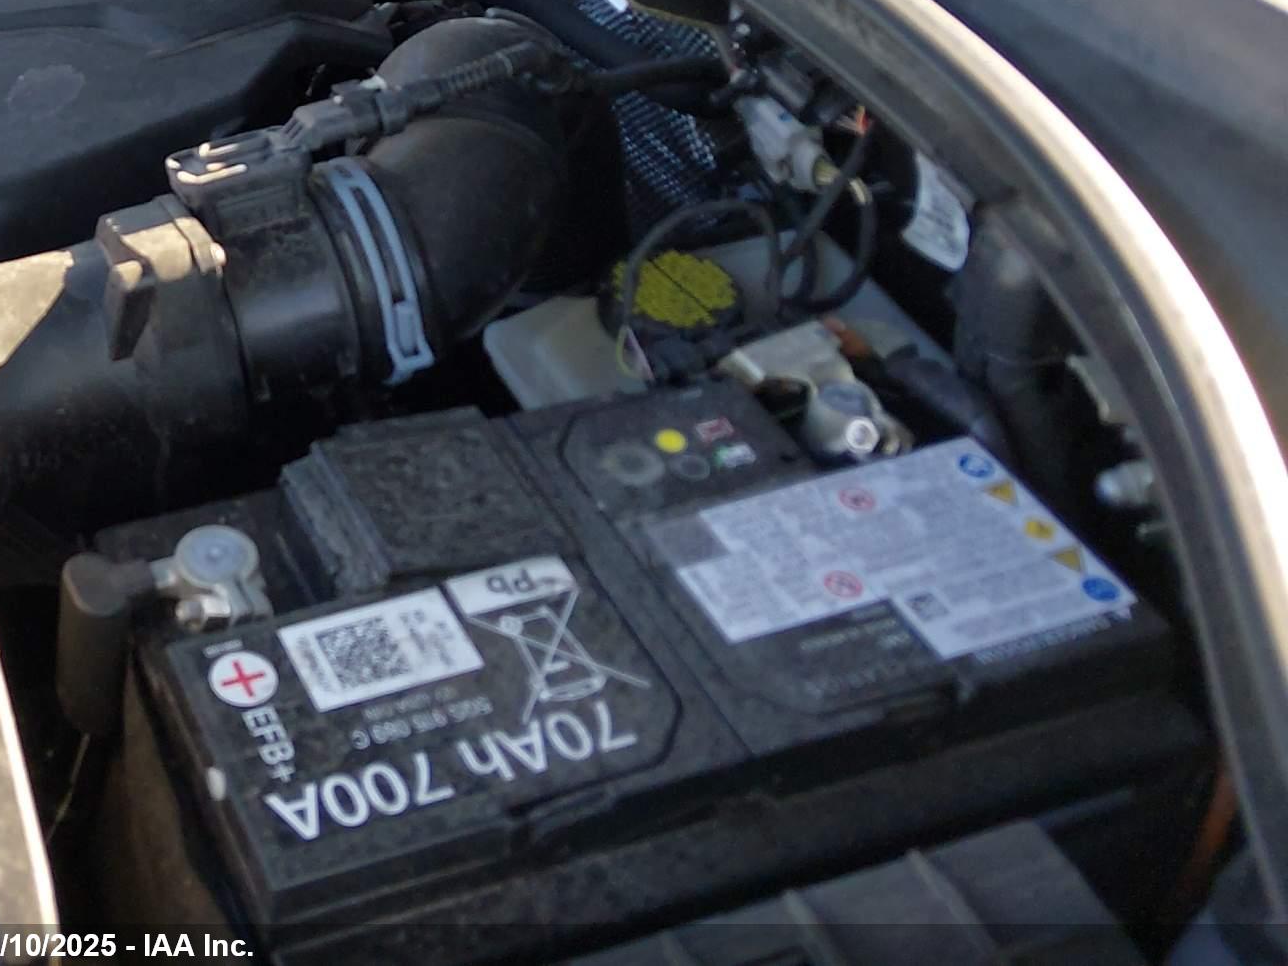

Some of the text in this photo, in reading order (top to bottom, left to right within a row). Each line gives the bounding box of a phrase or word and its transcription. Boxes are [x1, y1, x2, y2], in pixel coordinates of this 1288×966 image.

[486, 569, 535, 594] Pb
[243, 704, 296, 782] EFB+
[457, 699, 638, 782] 70Ah
[265, 751, 456, 841] 700A
